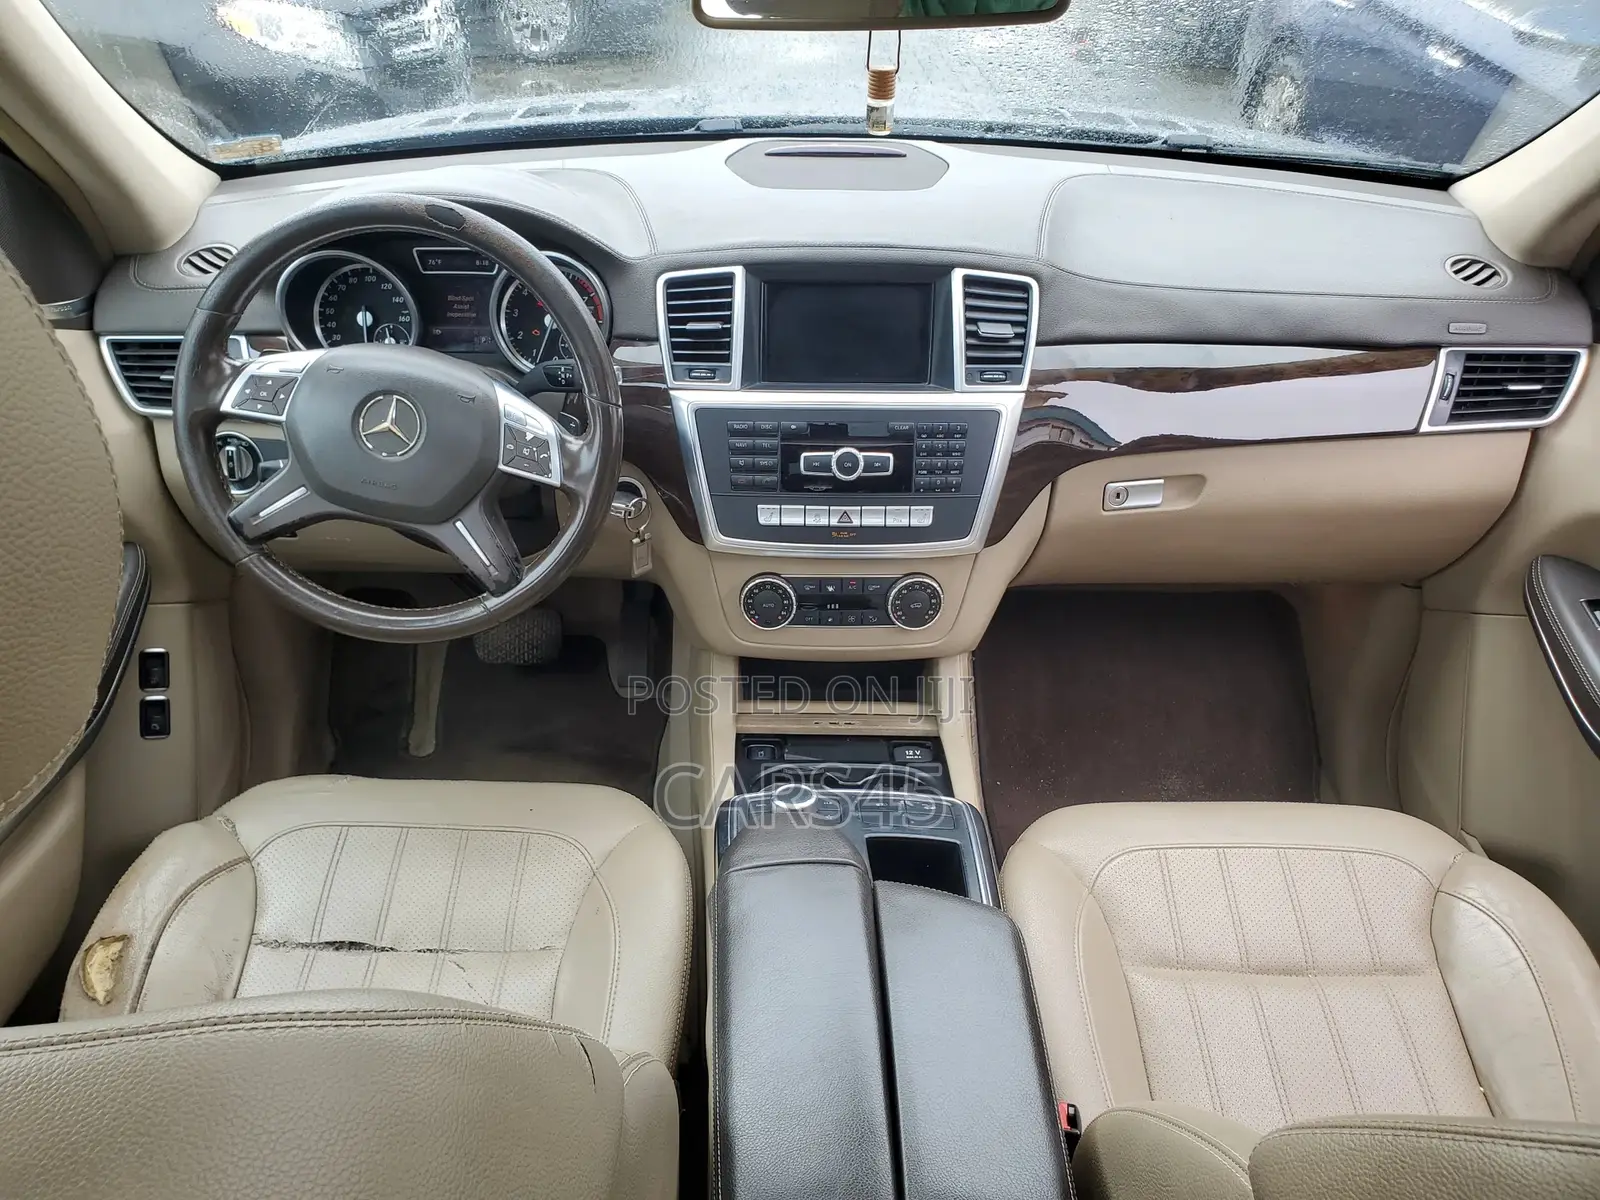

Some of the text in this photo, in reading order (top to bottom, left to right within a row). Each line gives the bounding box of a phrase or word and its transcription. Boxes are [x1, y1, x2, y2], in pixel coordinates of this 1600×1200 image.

[522, 288, 528, 296] 4
[512, 308, 519, 317] 3
[517, 331, 524, 339] 2
[531, 348, 537, 357] 1
